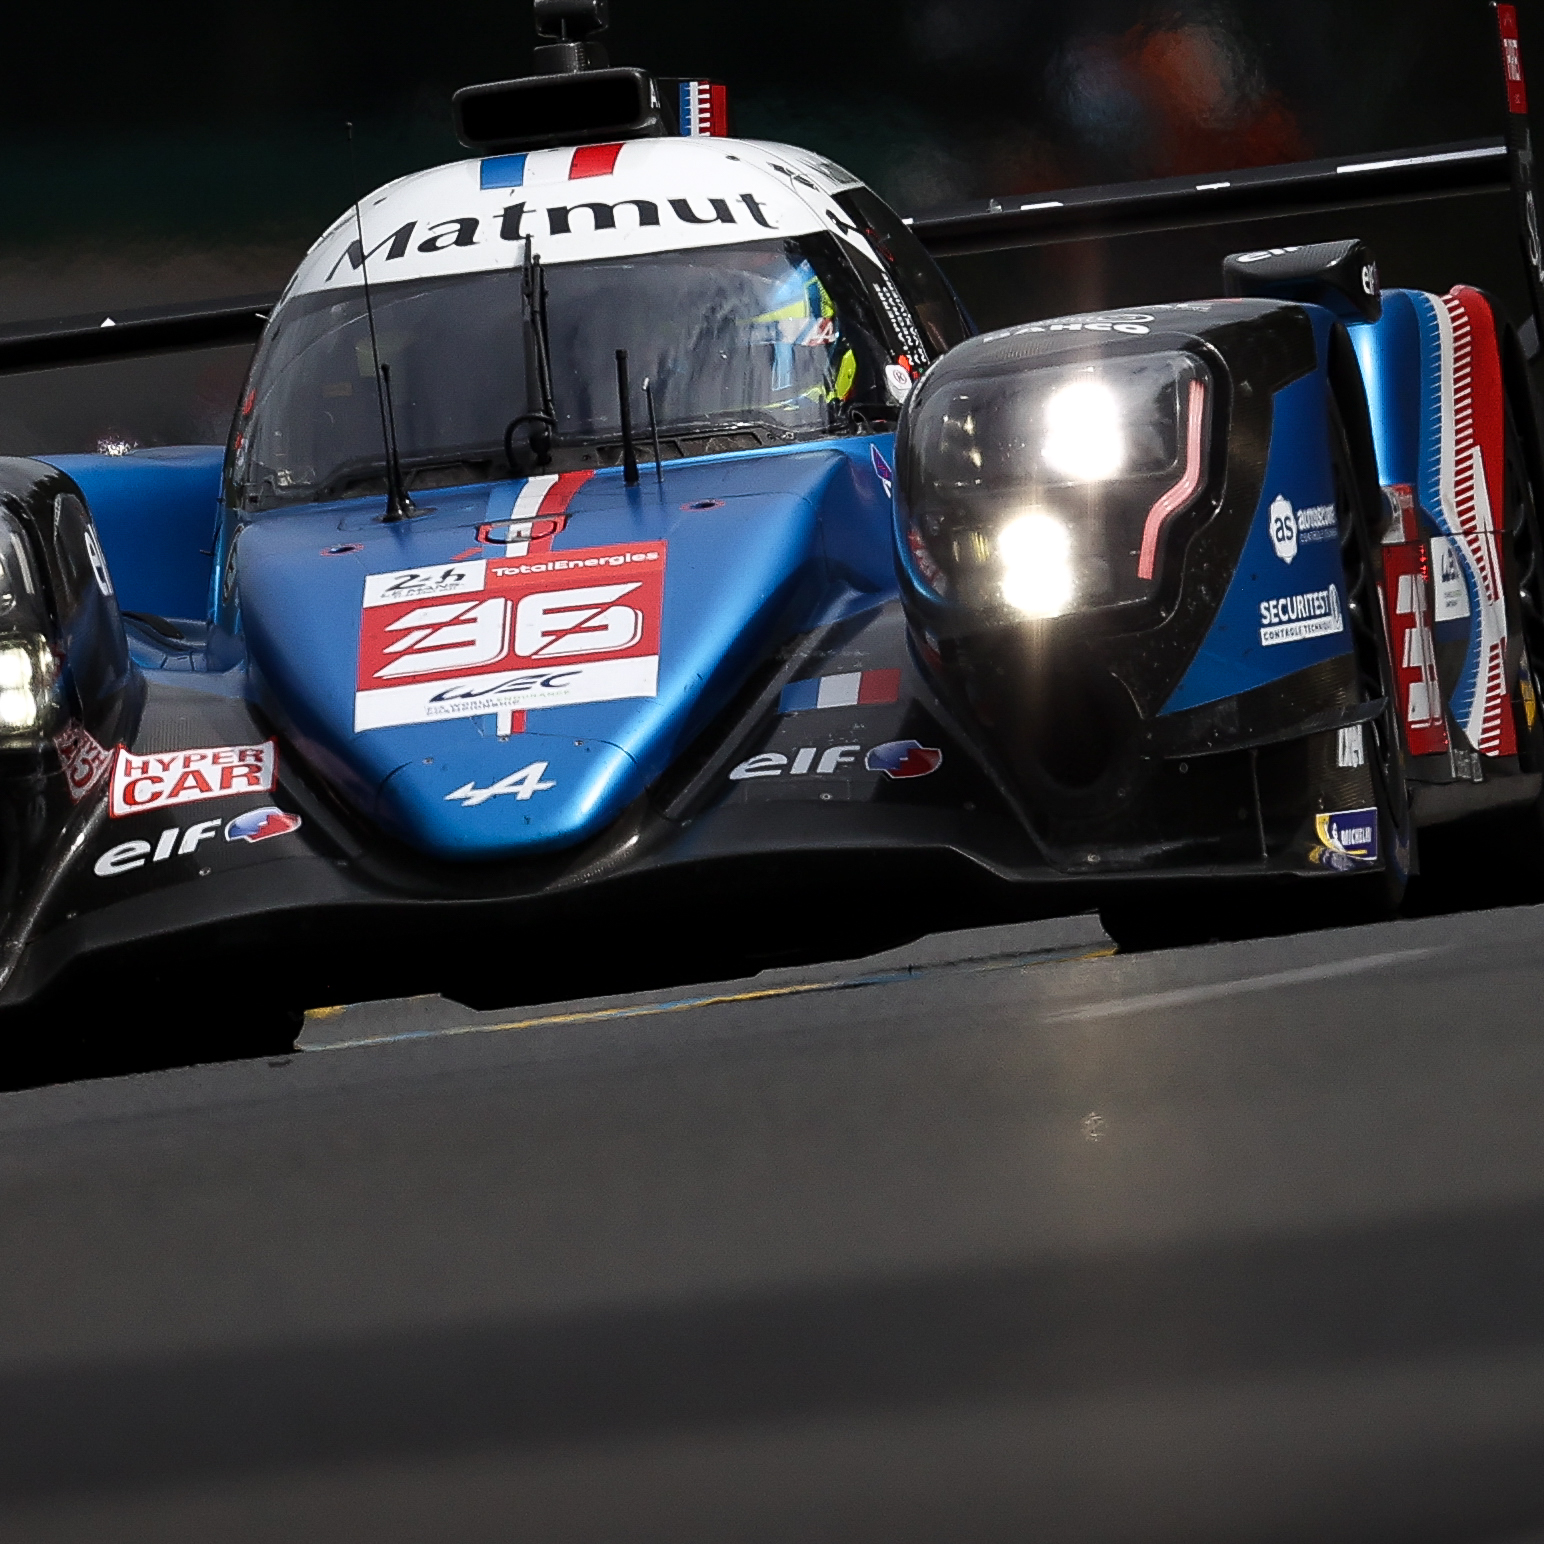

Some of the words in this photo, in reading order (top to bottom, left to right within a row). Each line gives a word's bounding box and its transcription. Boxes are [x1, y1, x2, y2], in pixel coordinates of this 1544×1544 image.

[325, 193, 779, 282] Matmut
[492, 551, 660, 577] TotalEnergies
[1260, 589, 1330, 625] SECURITEST
[372, 581, 644, 679] 36
[124, 748, 264, 777] HYPER
[728, 744, 861, 781] elf
[123, 763, 262, 806] CAR
[93, 818, 222, 878] elf
